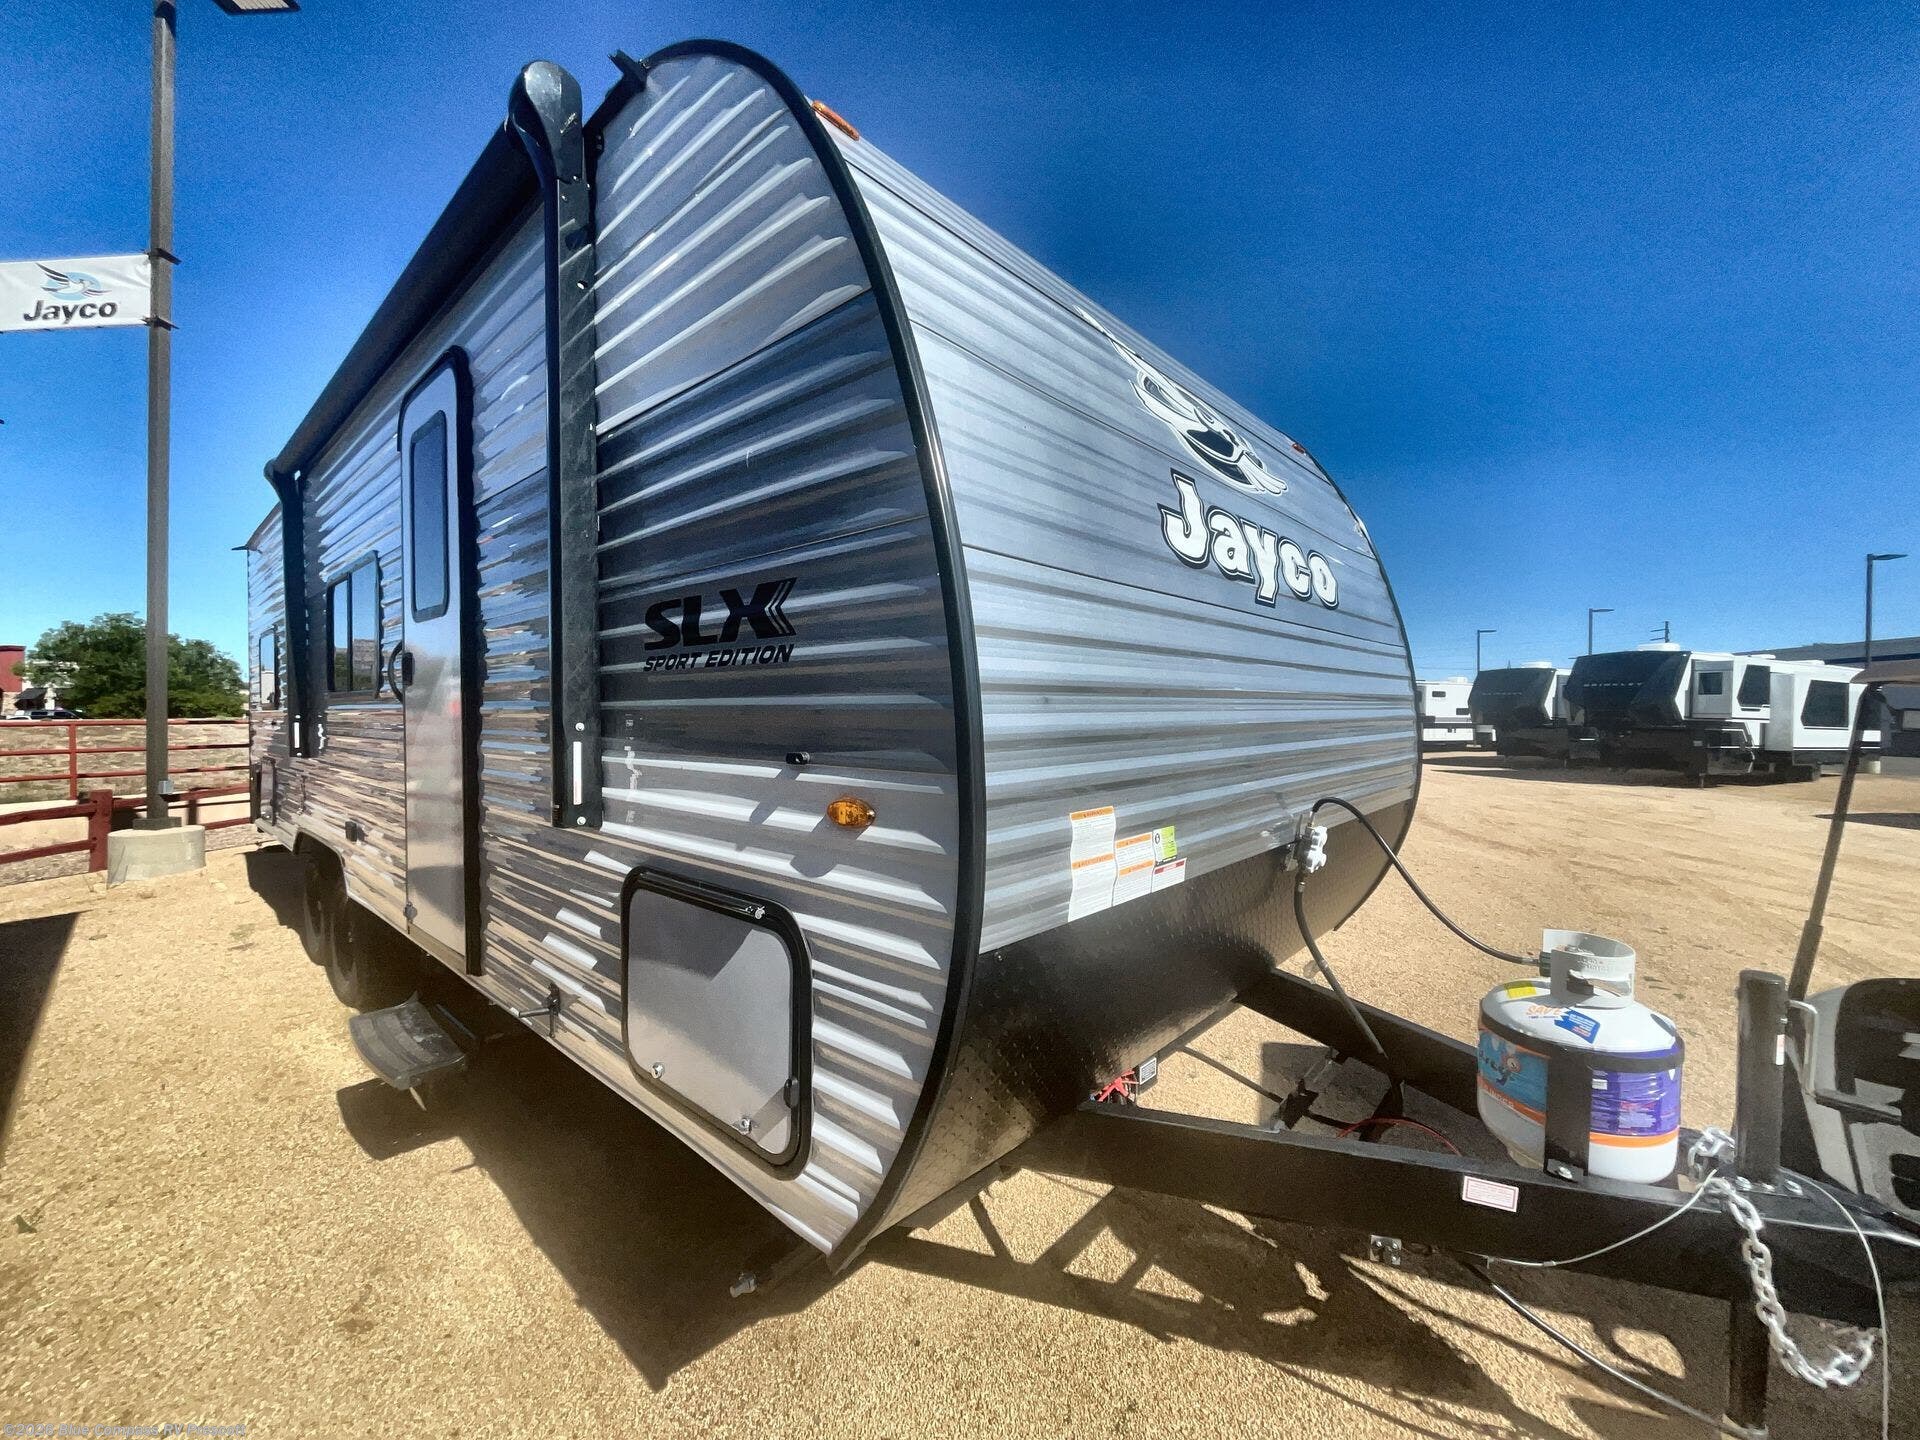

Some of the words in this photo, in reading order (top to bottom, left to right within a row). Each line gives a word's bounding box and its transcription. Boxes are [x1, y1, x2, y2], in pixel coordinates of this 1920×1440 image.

[23, 299, 118, 324] Jayco
[1157, 468, 1339, 610] Jayco
[644, 577, 797, 650] SLX
[643, 652, 702, 672] SPORT
[704, 644, 795, 668] EDITION
